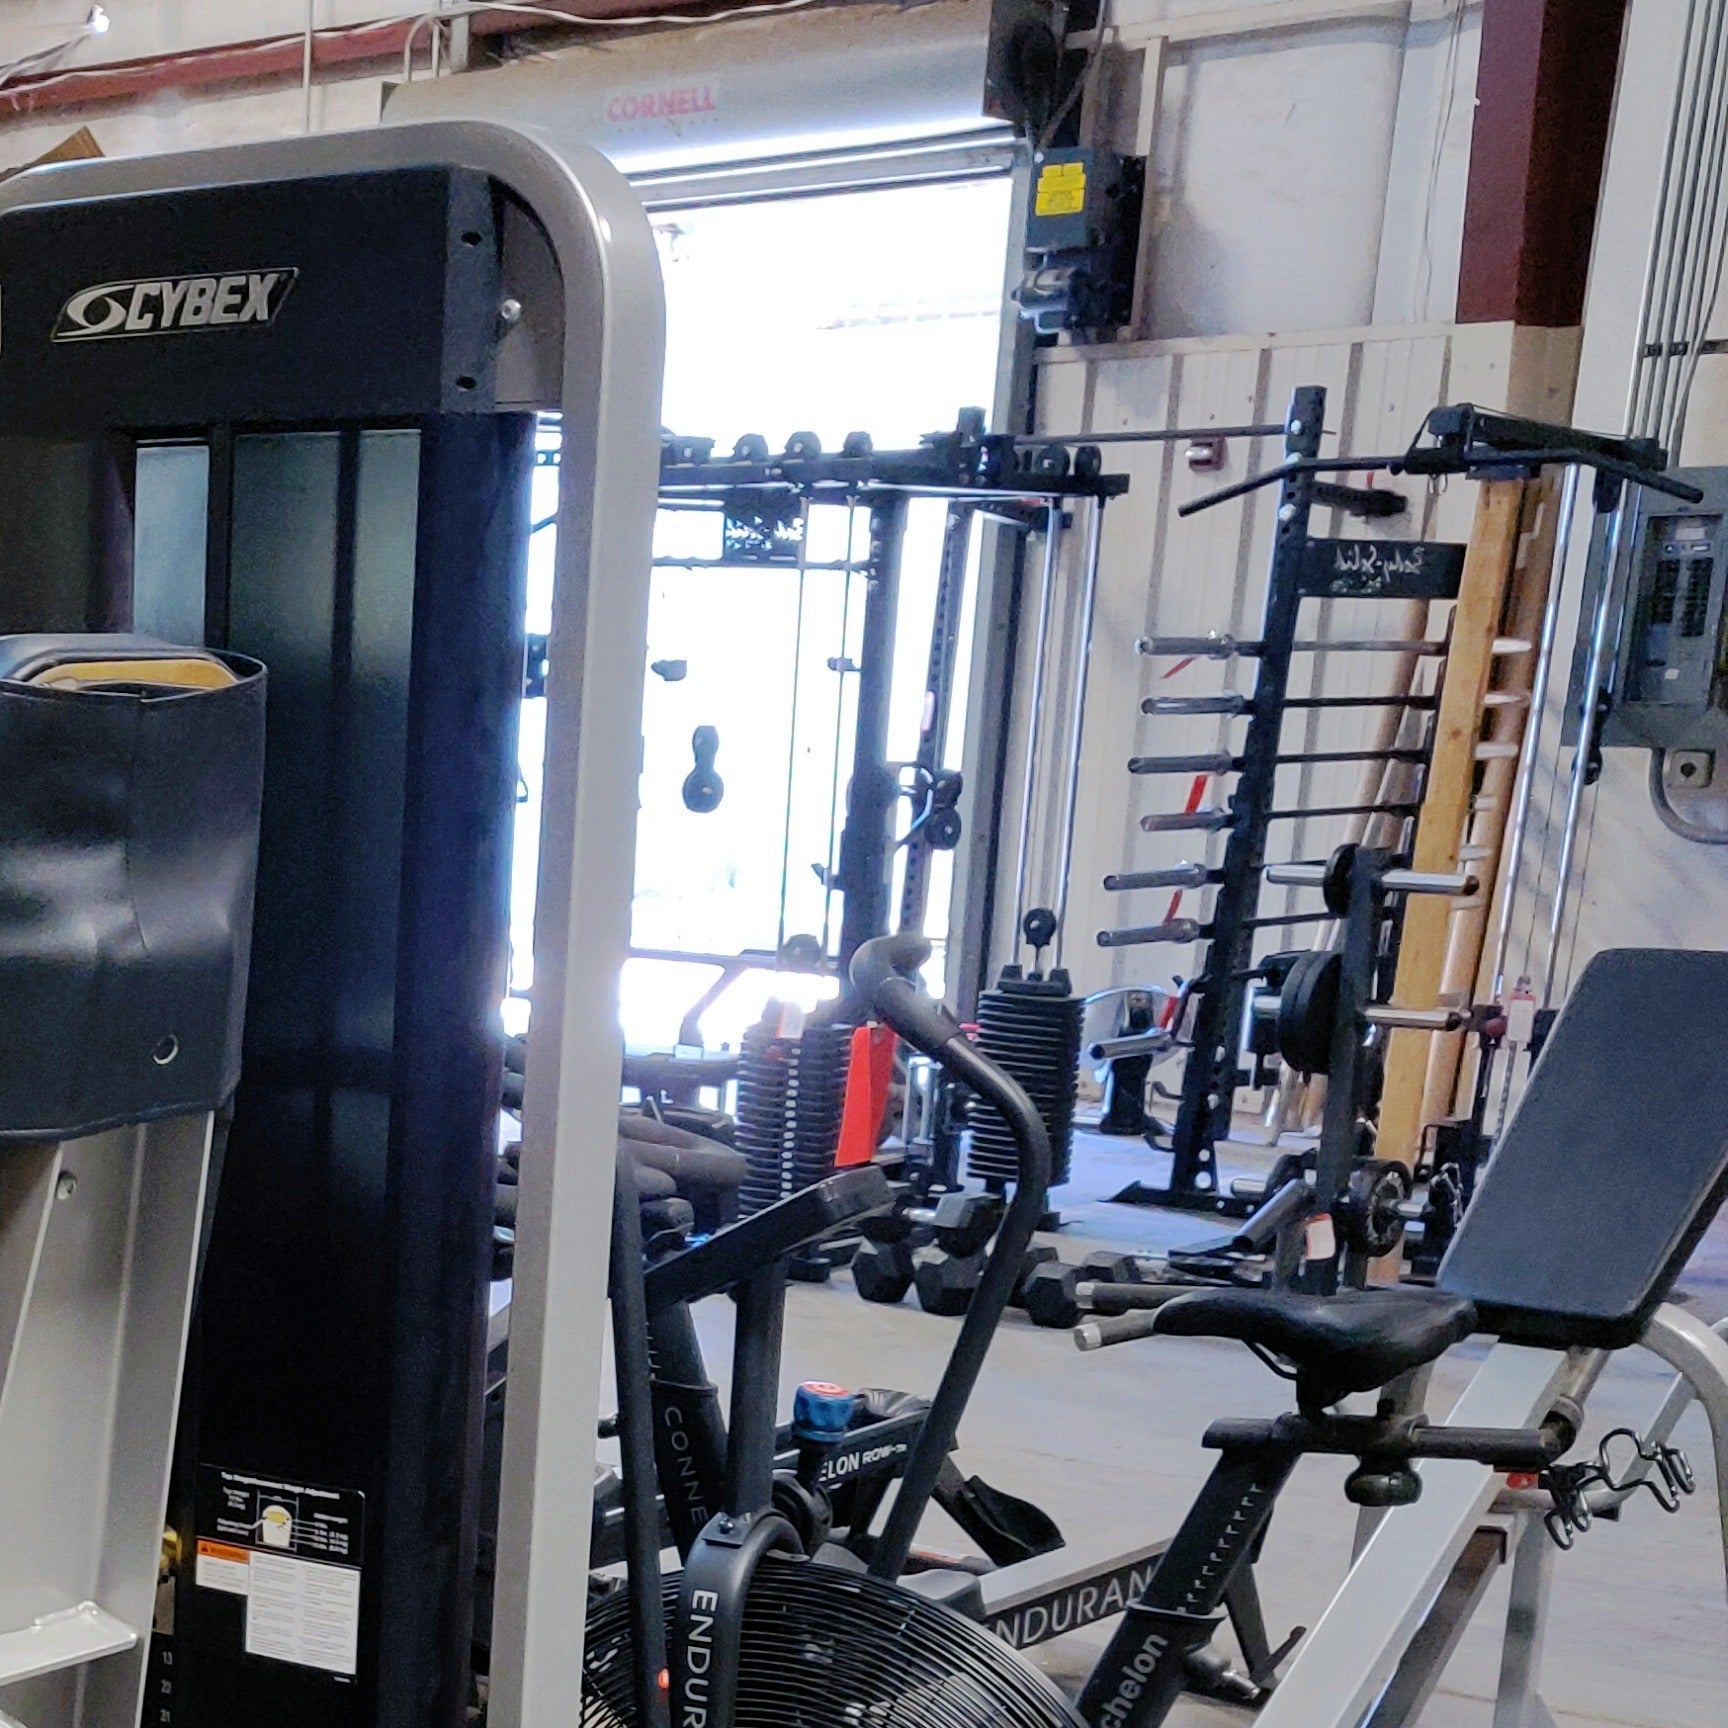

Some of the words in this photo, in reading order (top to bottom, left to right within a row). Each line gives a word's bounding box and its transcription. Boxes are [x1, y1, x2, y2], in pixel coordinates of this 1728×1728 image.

[124, 273, 282, 331] CYBEX
[663, 1406, 710, 1525] CONNE
[818, 1451, 860, 1482] ELON
[984, 1564, 1154, 1648] NDURAN
